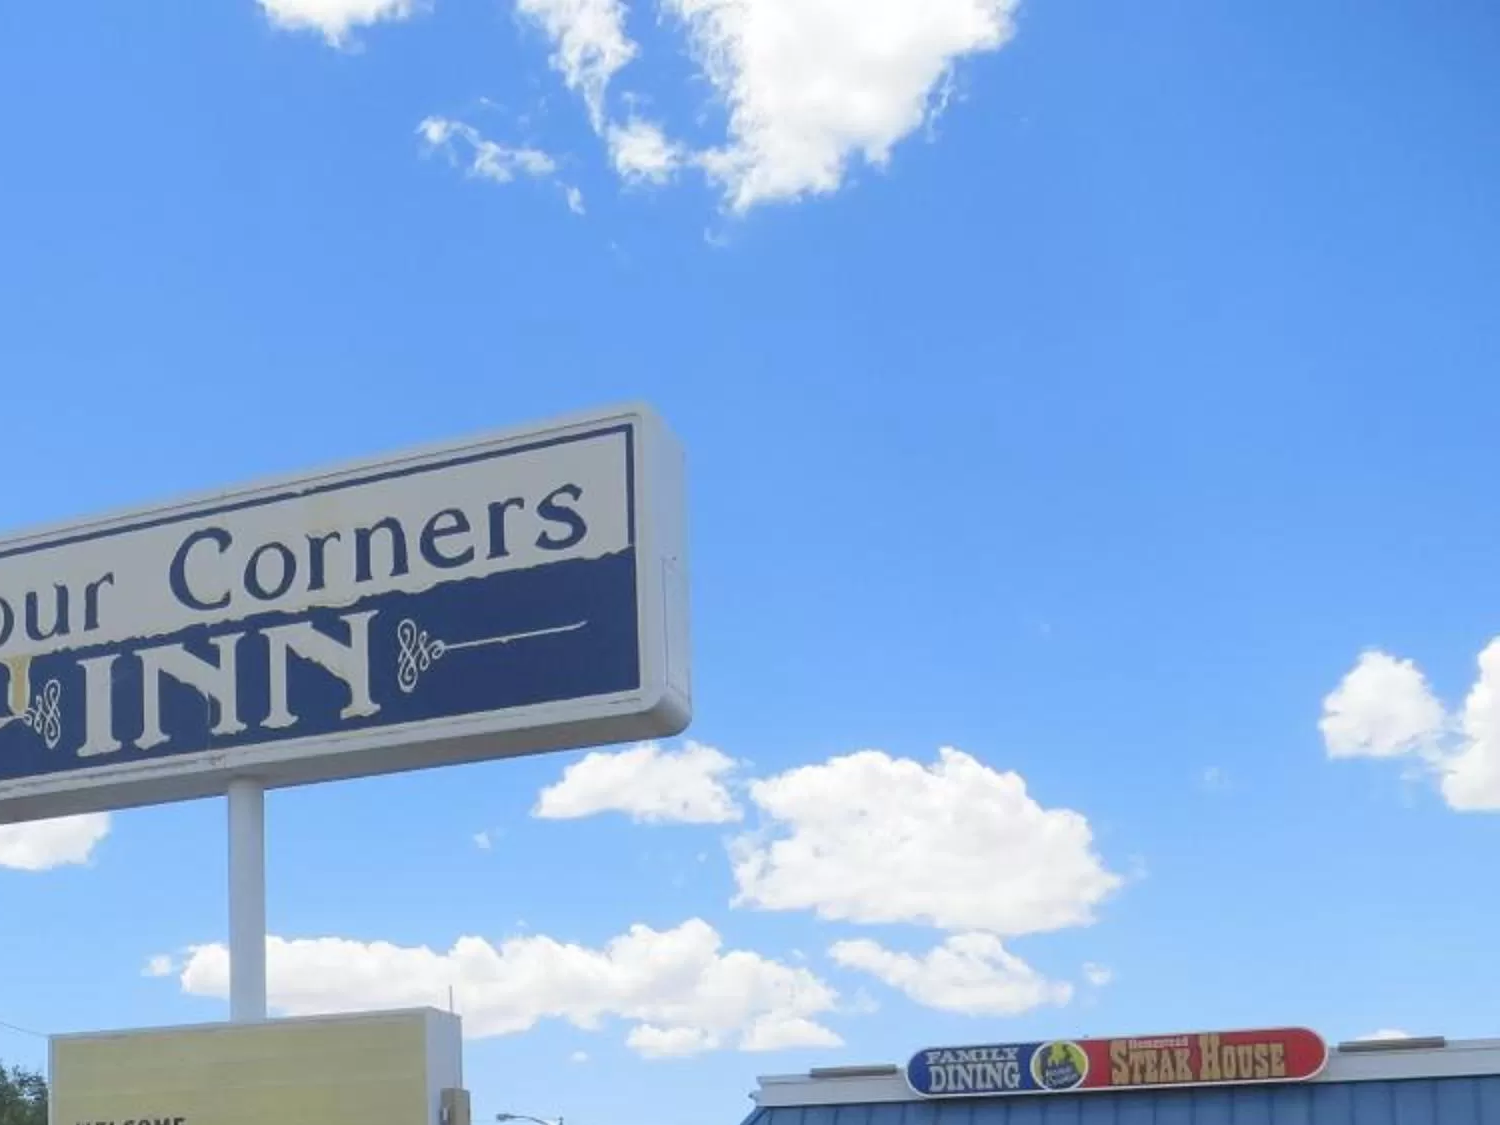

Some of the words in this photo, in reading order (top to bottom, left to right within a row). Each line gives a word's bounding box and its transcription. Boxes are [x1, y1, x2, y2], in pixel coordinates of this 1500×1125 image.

[169, 482, 588, 612] Corners
[74, 608, 384, 760] INN
[925, 1047, 1020, 1065] FAMILY
[928, 1062, 1021, 1092] DINING
